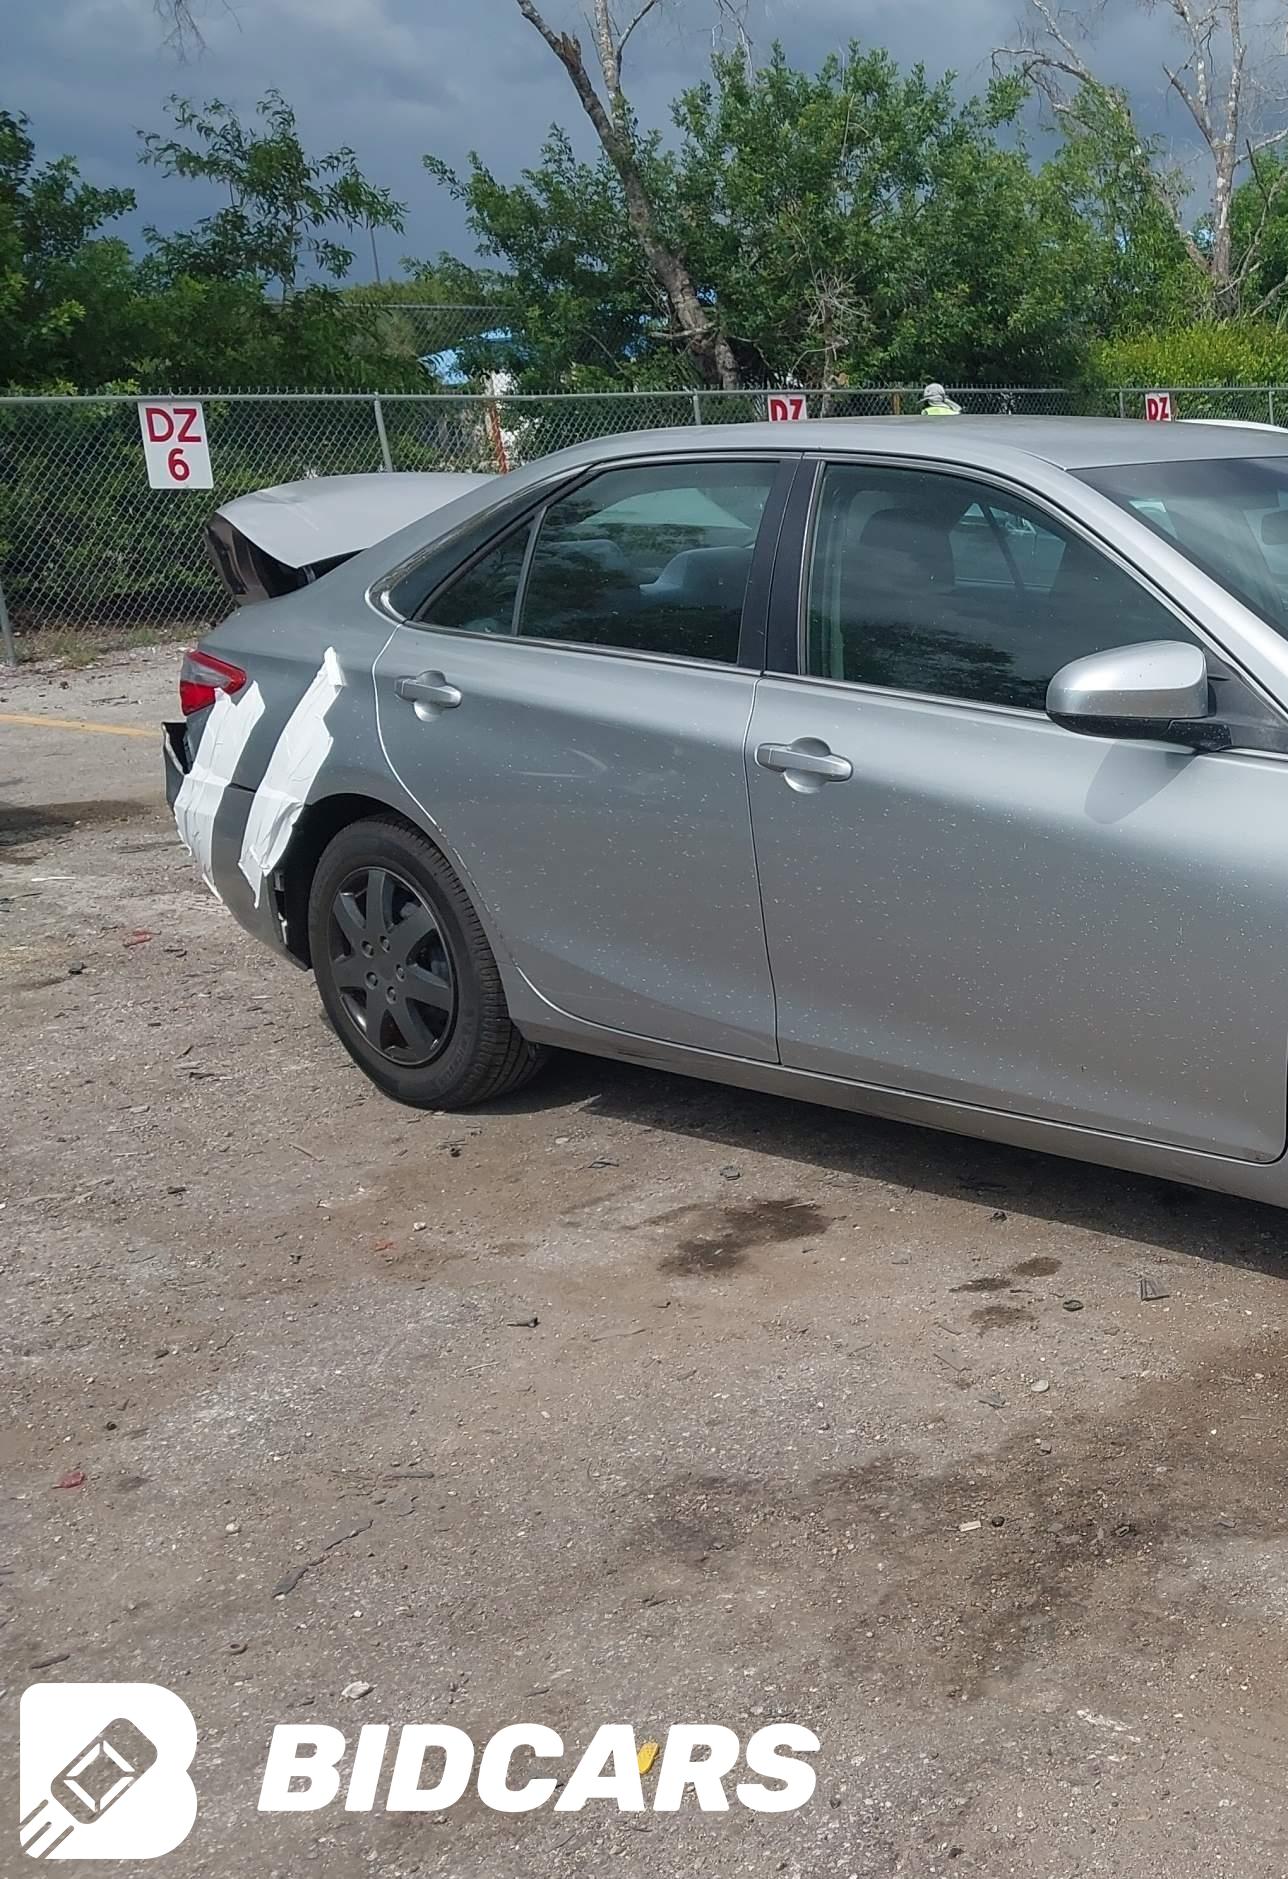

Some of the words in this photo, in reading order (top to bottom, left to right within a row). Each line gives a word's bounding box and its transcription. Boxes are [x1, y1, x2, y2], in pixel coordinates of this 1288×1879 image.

[145, 407, 202, 443] DZ
[1147, 397, 1169, 420] DZ
[167, 447, 191, 482] 6
